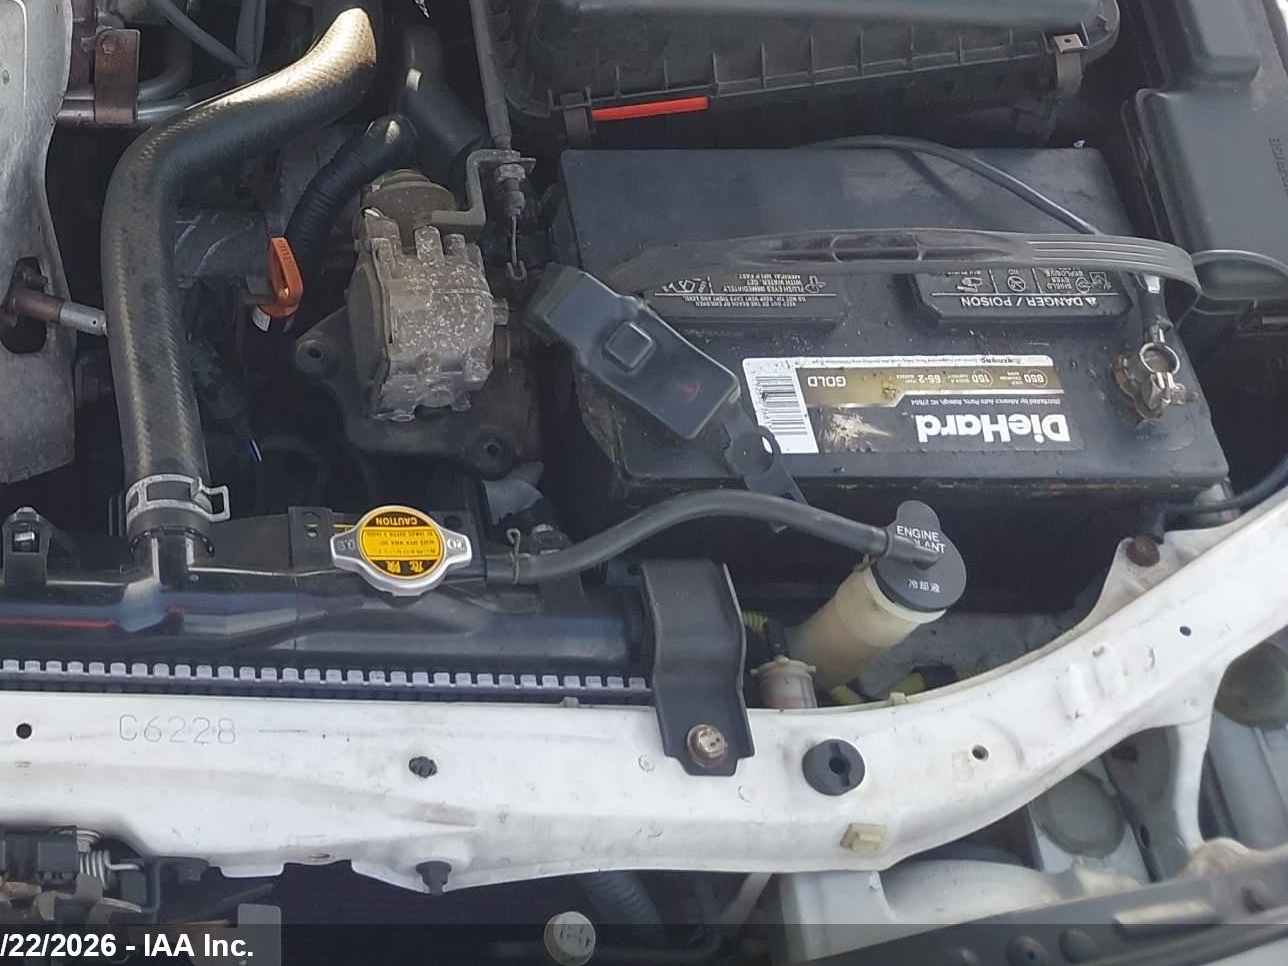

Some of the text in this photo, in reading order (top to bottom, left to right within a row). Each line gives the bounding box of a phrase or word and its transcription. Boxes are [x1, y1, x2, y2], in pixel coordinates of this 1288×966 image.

[961, 296, 1011, 306] POISON
[1025, 296, 1084, 306] DANGER
[807, 375, 847, 387] GOLD
[914, 413, 1071, 444] DieHard
[375, 516, 418, 526] CAUTION
[896, 525, 940, 542] ENGINE
[119, 714, 237, 745] C6228
